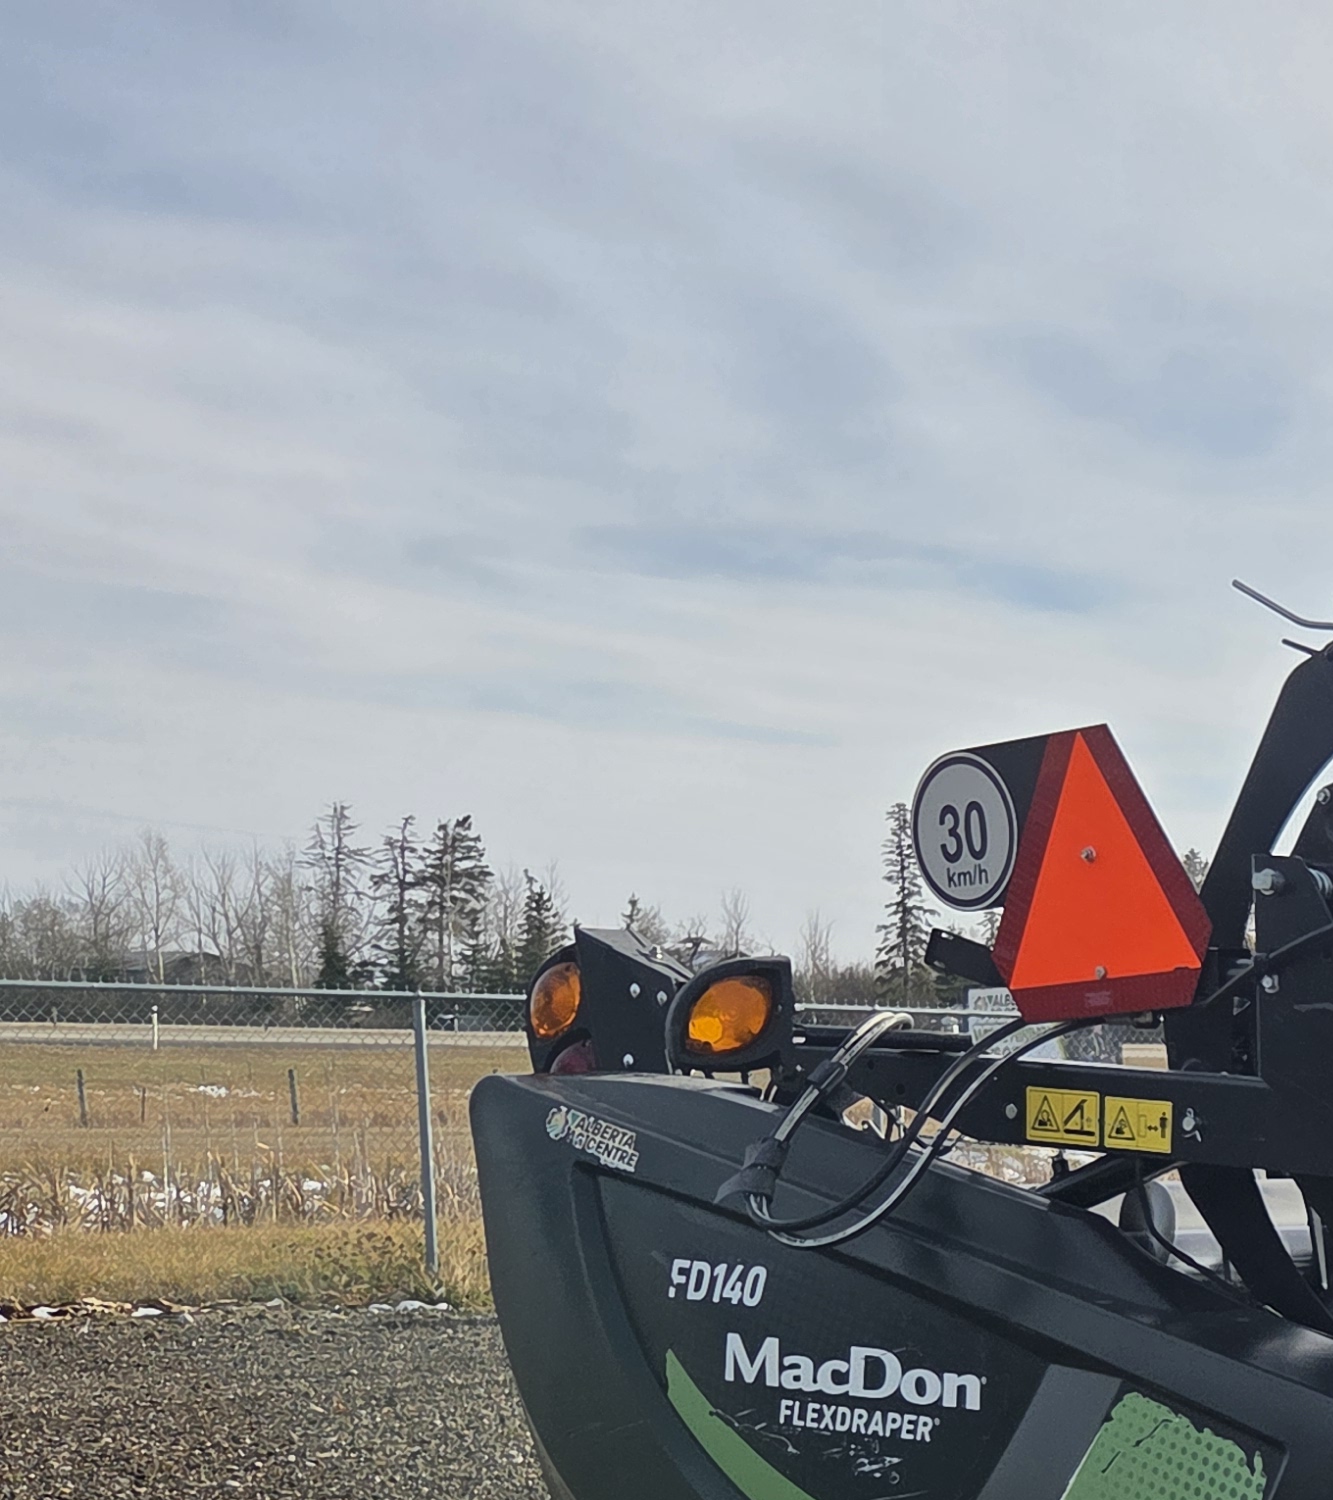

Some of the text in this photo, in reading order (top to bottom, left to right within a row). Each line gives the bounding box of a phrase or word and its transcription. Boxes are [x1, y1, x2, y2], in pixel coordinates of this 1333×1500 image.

[938, 800, 988, 864] 30
[946, 863, 989, 888] km/h
[575, 1116, 635, 1149] ALBERTA
[586, 1137, 638, 1167] CENTRE
[668, 1258, 768, 1307] FD140
[724, 1332, 981, 1411] MacDon
[779, 1399, 934, 1443] FLEXDRAPER
